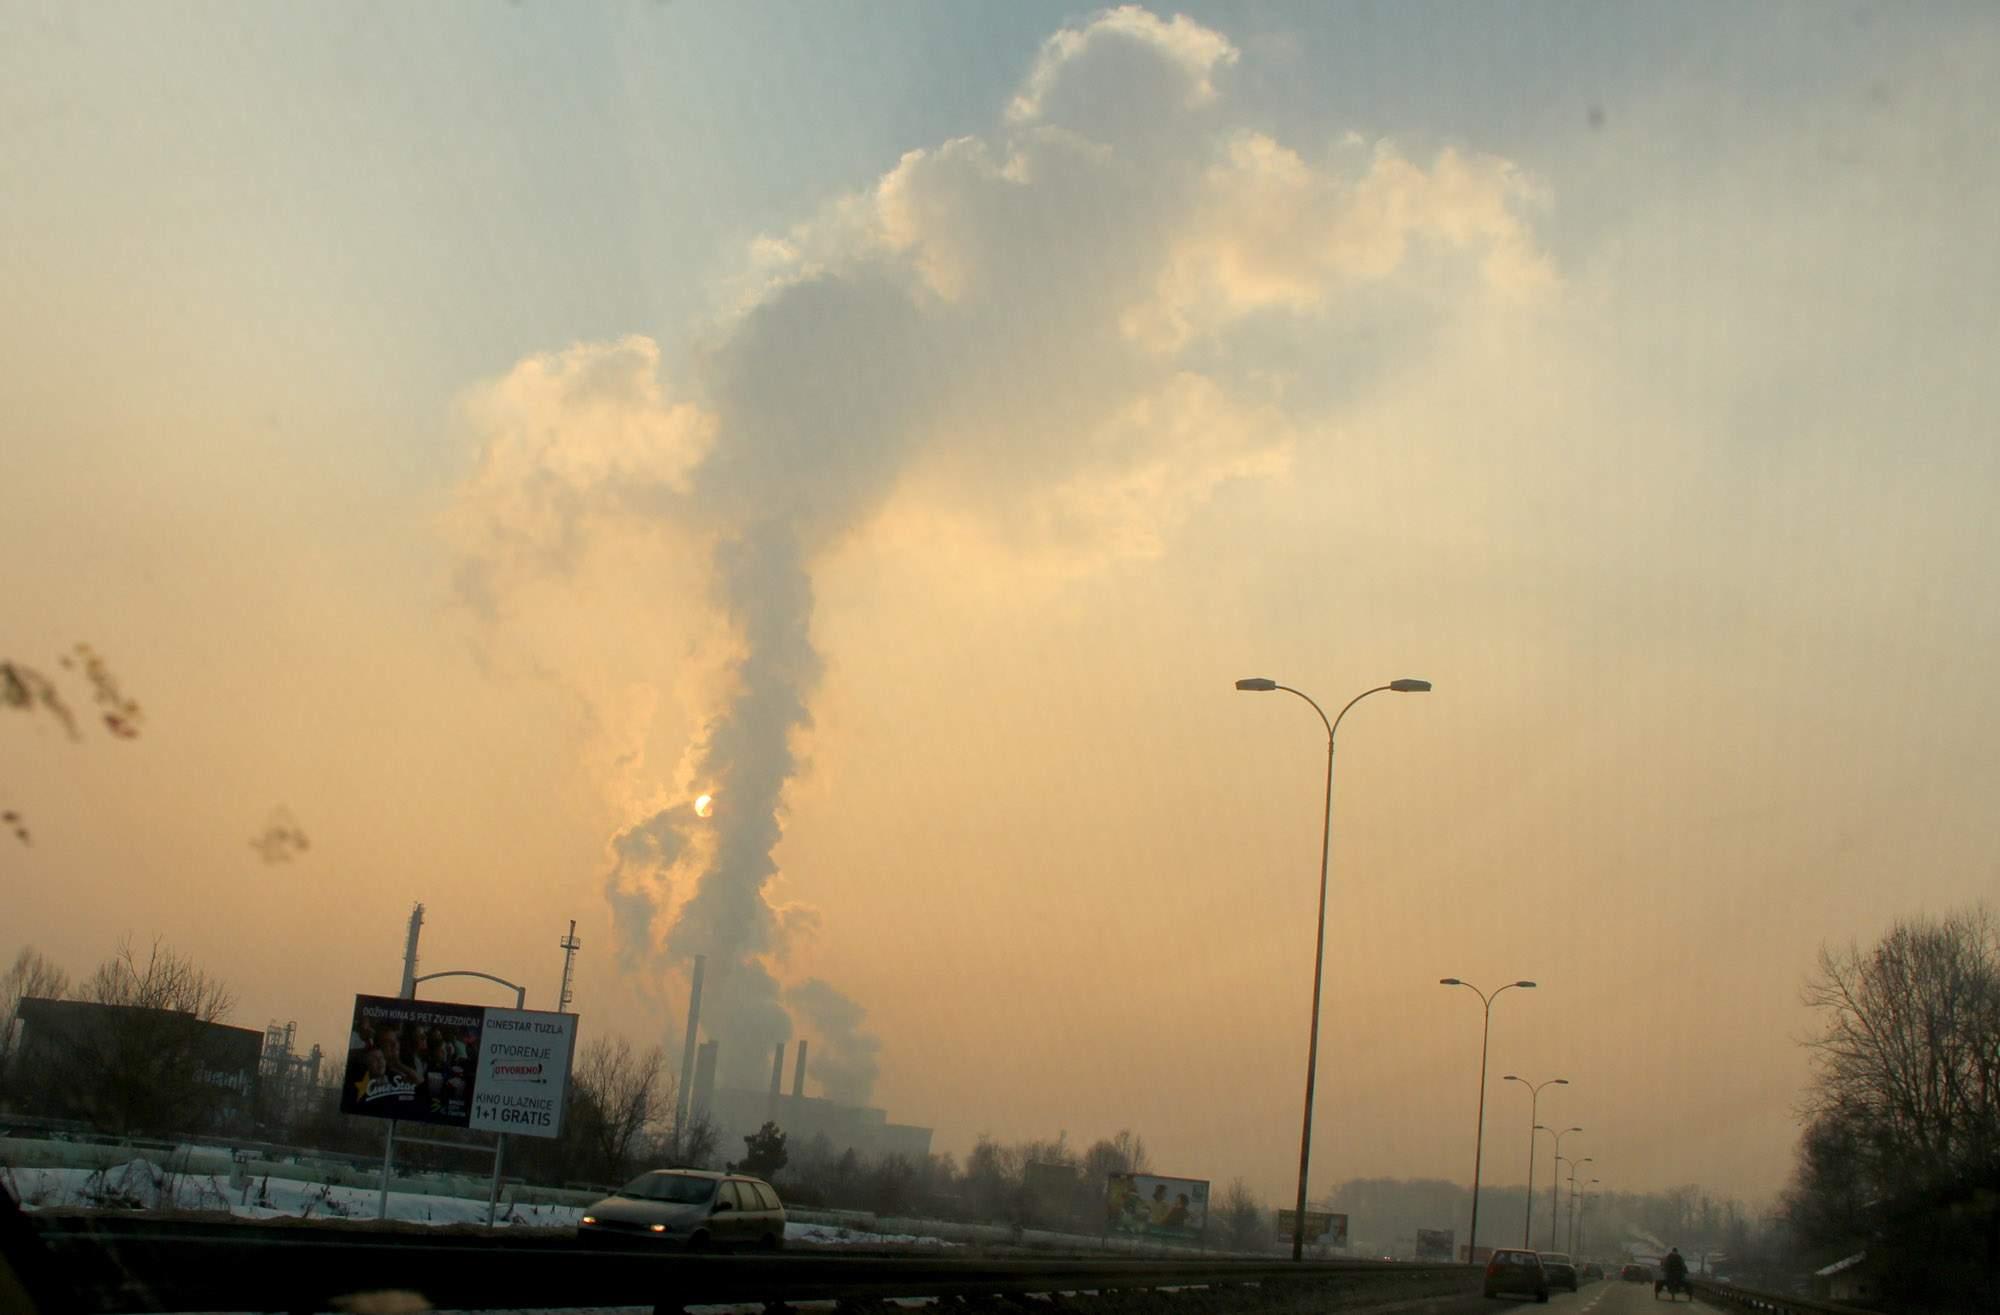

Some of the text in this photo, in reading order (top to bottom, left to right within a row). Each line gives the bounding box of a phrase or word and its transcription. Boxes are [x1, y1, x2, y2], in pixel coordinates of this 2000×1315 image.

[417, 1012, 433, 1023] PET
[433, 1014, 480, 1026] ZVJEZDICA!
[486, 1019, 564, 1034] CINESTAR TUZLA
[490, 1043, 552, 1059] OTVORENJE
[495, 1065, 538, 1076] OTVORENO
[475, 1094, 554, 1111] KINO ULAZNICE
[475, 1105, 497, 1121] 1+1
[501, 1108, 552, 1127] GRATIS
